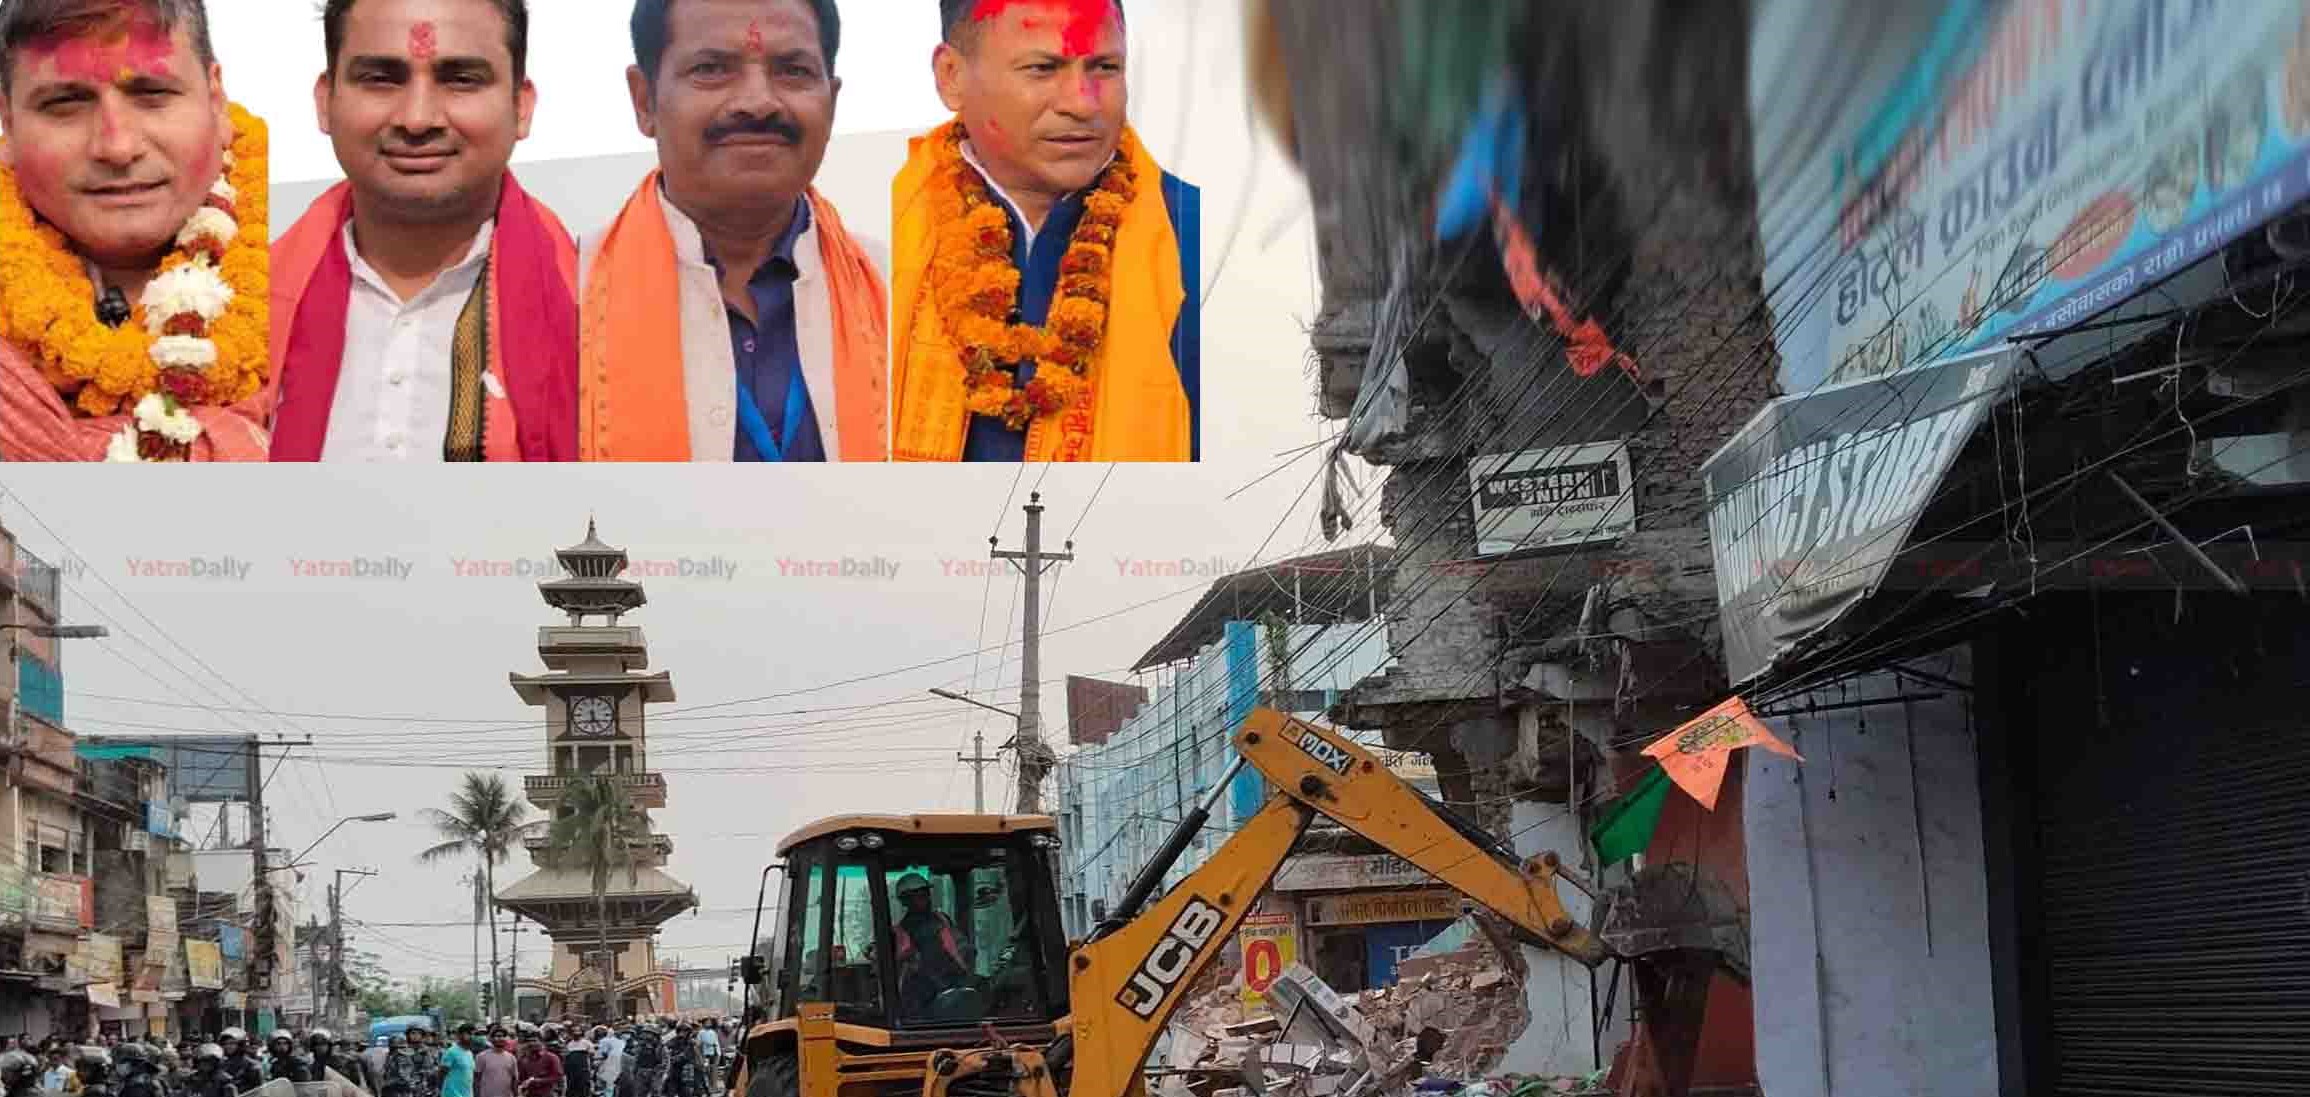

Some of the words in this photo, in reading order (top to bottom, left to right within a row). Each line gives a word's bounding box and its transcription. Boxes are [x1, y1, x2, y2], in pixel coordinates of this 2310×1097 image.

[1487, 471, 1591, 495] WESTERN
[1521, 485, 1591, 504] UNION
[1119, 901, 1222, 1016] JCB
